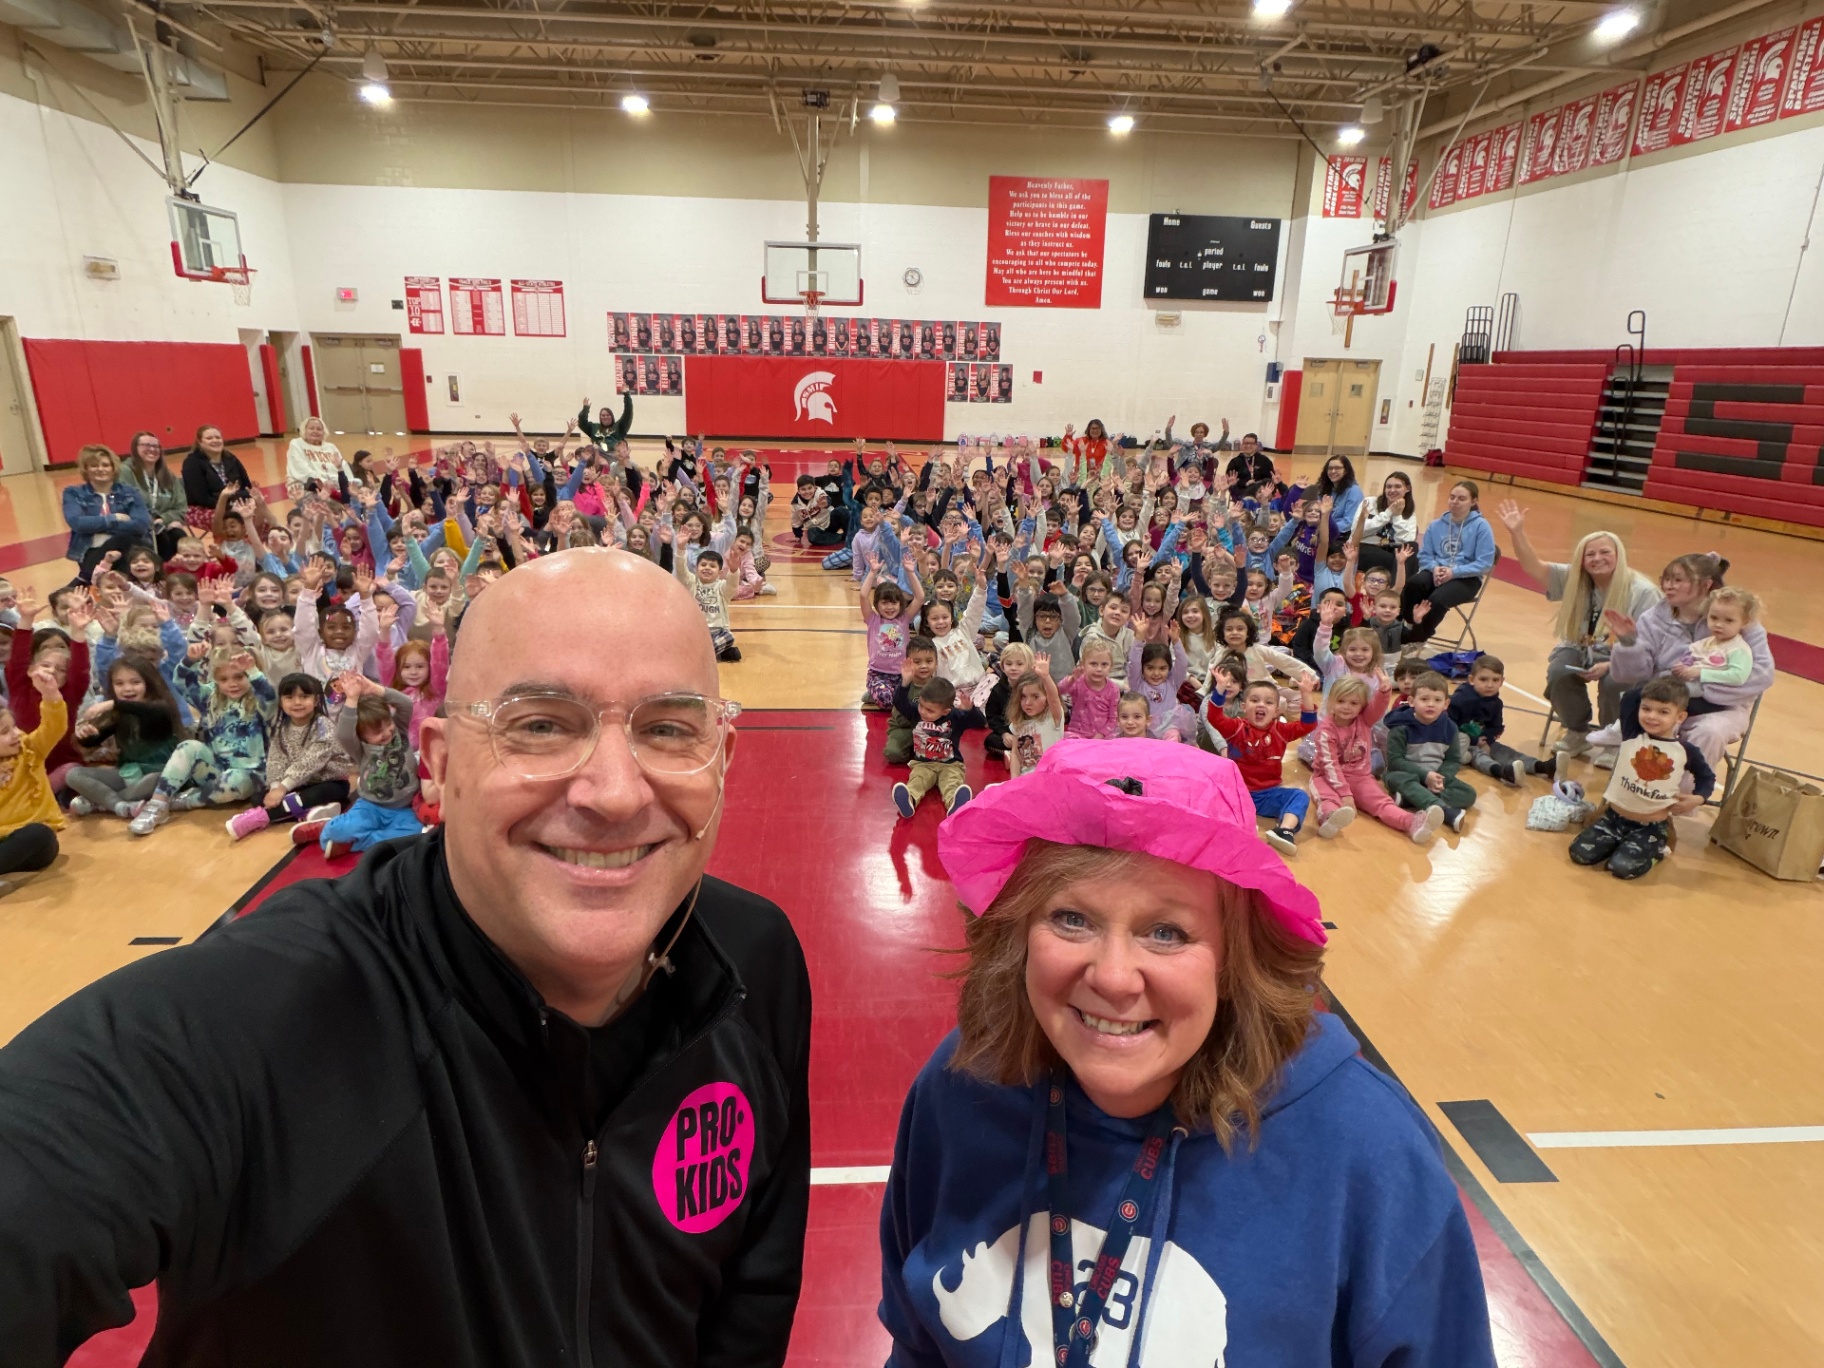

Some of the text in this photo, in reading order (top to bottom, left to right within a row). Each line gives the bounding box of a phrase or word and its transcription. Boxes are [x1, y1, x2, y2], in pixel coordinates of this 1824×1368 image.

[1730, 51, 1750, 120] SPARTANS
[1735, 43, 1760, 125] BASKETBALL
[1785, 30, 1810, 109] SPARTANS
[1794, 21, 1821, 110] BASKETBALL
[1636, 83, 1653, 144] SPARTANS
[1641, 78, 1661, 146] VOLLEYBALL
[1678, 69, 1698, 134] SPARTANS
[1684, 60, 1707, 138] BASKETBALL
[1027, 181, 1074, 190] Heavenly Father,
[1376, 164, 1385, 211] SPARTANS
[1381, 160, 1392, 216] BASKETBALL
[1163, 217, 1271, 230] Home Guests
[1205, 248, 1223, 256] period
[1156, 259, 1171, 268] fouls
[1203, 261, 1223, 270] player
[1254, 263, 1269, 272] fouls
[1202, 288, 1218, 296] game
[410, 307, 420, 316] 10
[1675, 384, 1804, 480] S
[676, 1148, 742, 1222] KIDS
[1141, 1137, 1163, 1180] CUBS
[1097, 1258, 1120, 1299] CUBS
